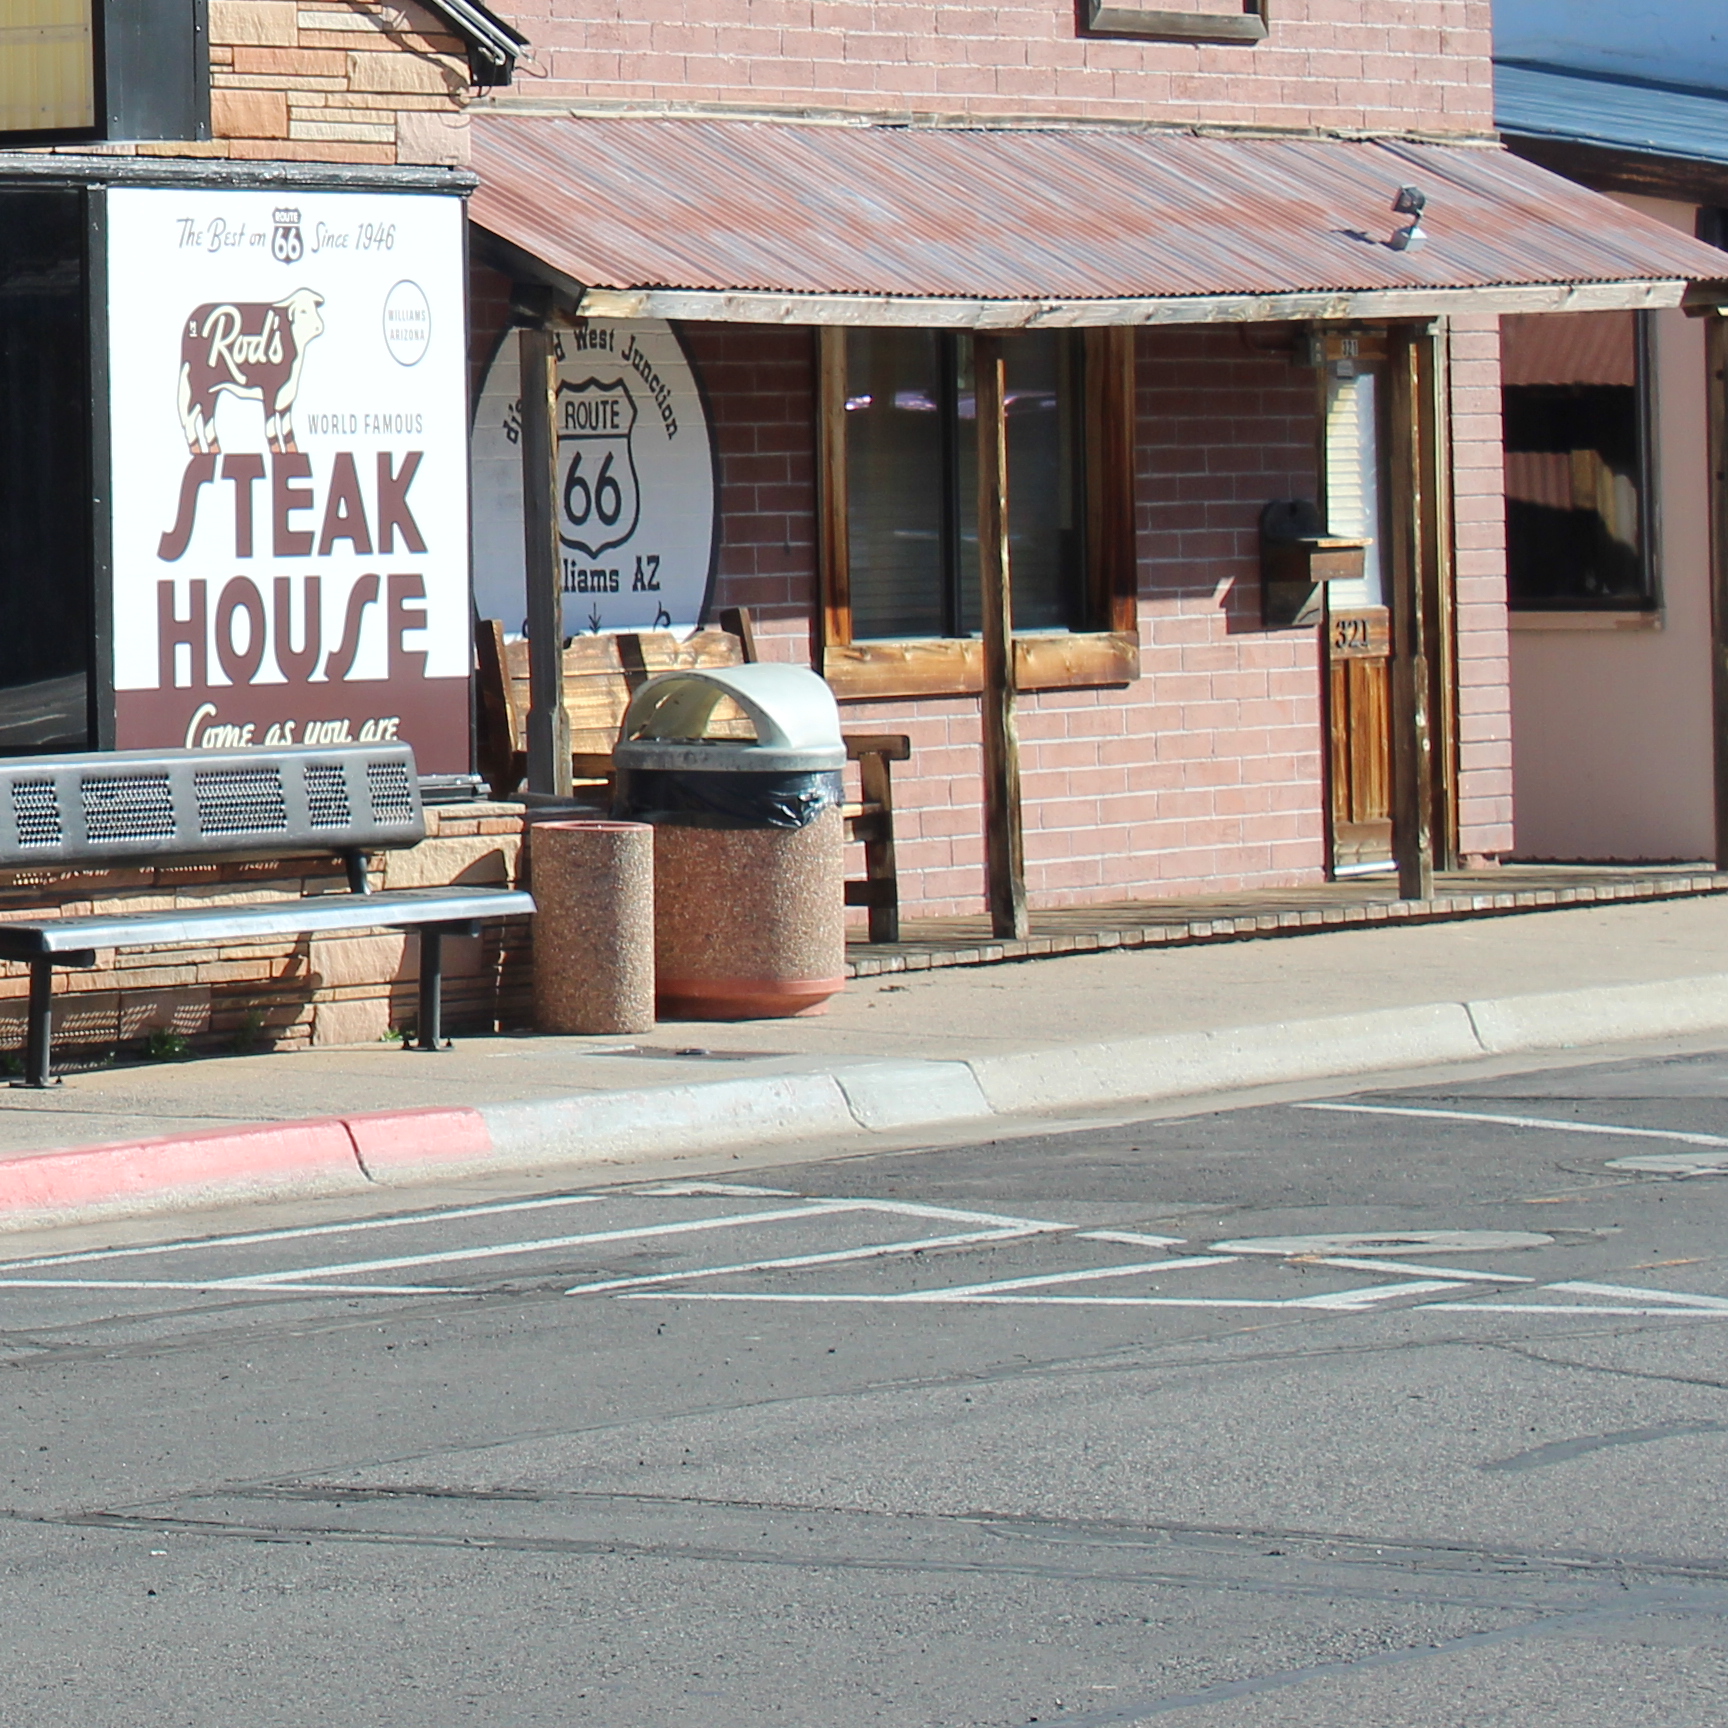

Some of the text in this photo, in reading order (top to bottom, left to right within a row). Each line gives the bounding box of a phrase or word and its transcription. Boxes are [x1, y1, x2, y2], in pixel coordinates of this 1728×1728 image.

[274, 211, 299, 222] ROUTE
[175, 216, 266, 253] The Best on
[273, 227, 302, 261] 66
[310, 221, 396, 253] Since 1946
[387, 309, 426, 321] WILLIAMS
[202, 304, 283, 385] Rod's
[389, 328, 425, 341] ARIZONA
[573, 325, 615, 353] West
[621, 334, 679, 441] Junction
[307, 412, 423, 434] WORLD FAMOUS
[564, 400, 621, 431] ROUTE
[563, 450, 623, 527] 66
[156, 450, 429, 563] STEAK
[632, 554, 662, 592] AZ
[156, 572, 429, 689] HOUSE
[1335, 619, 1369, 648] 321
[184, 701, 256, 749] Come
[263, 719, 297, 747] as
[358, 716, 401, 743] are
